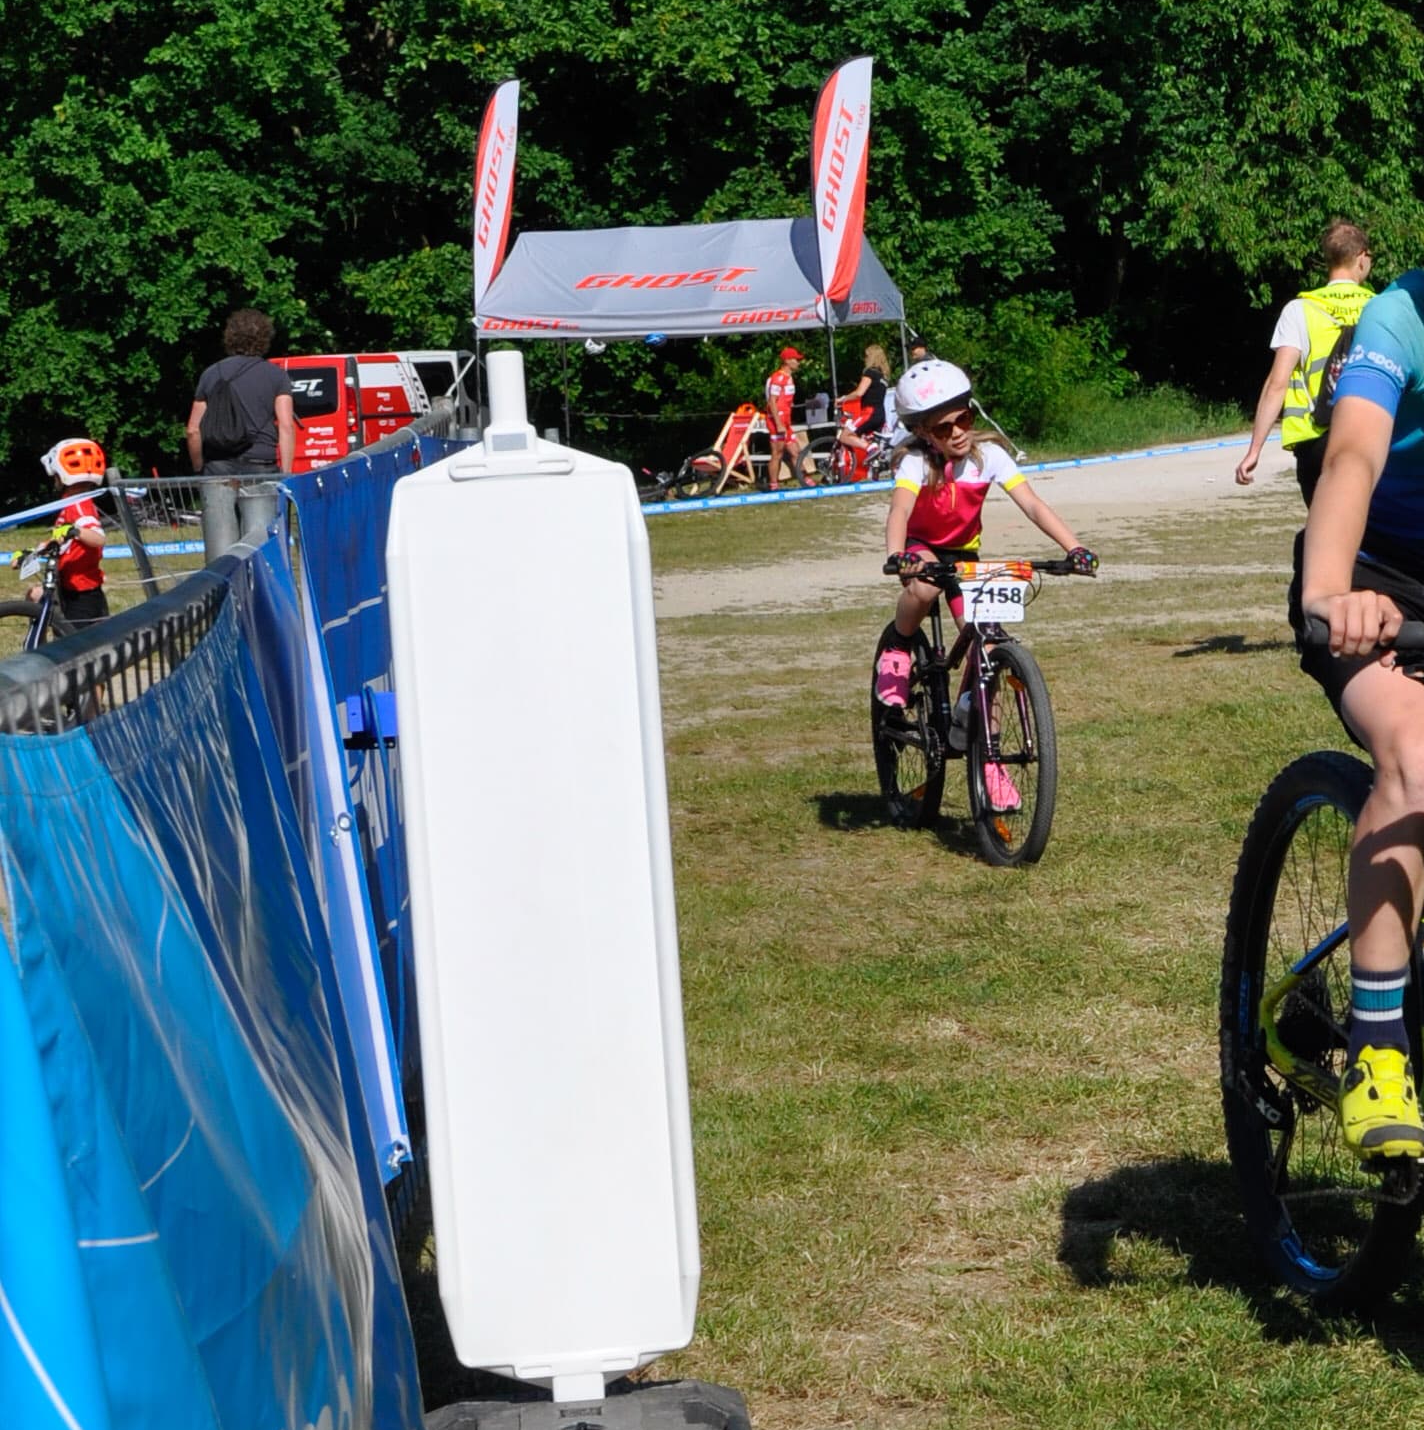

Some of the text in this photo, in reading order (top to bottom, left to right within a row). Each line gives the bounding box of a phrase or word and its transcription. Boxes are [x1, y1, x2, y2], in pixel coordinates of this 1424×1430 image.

[822, 99, 853, 232] GHOST
[477, 118, 506, 249] GHOST
[575, 266, 760, 290] GHOST
[712, 283, 750, 293] TEAM
[482, 317, 562, 331] GHOST
[720, 308, 807, 326] GHOST
[971, 587, 1022, 604] 2158
